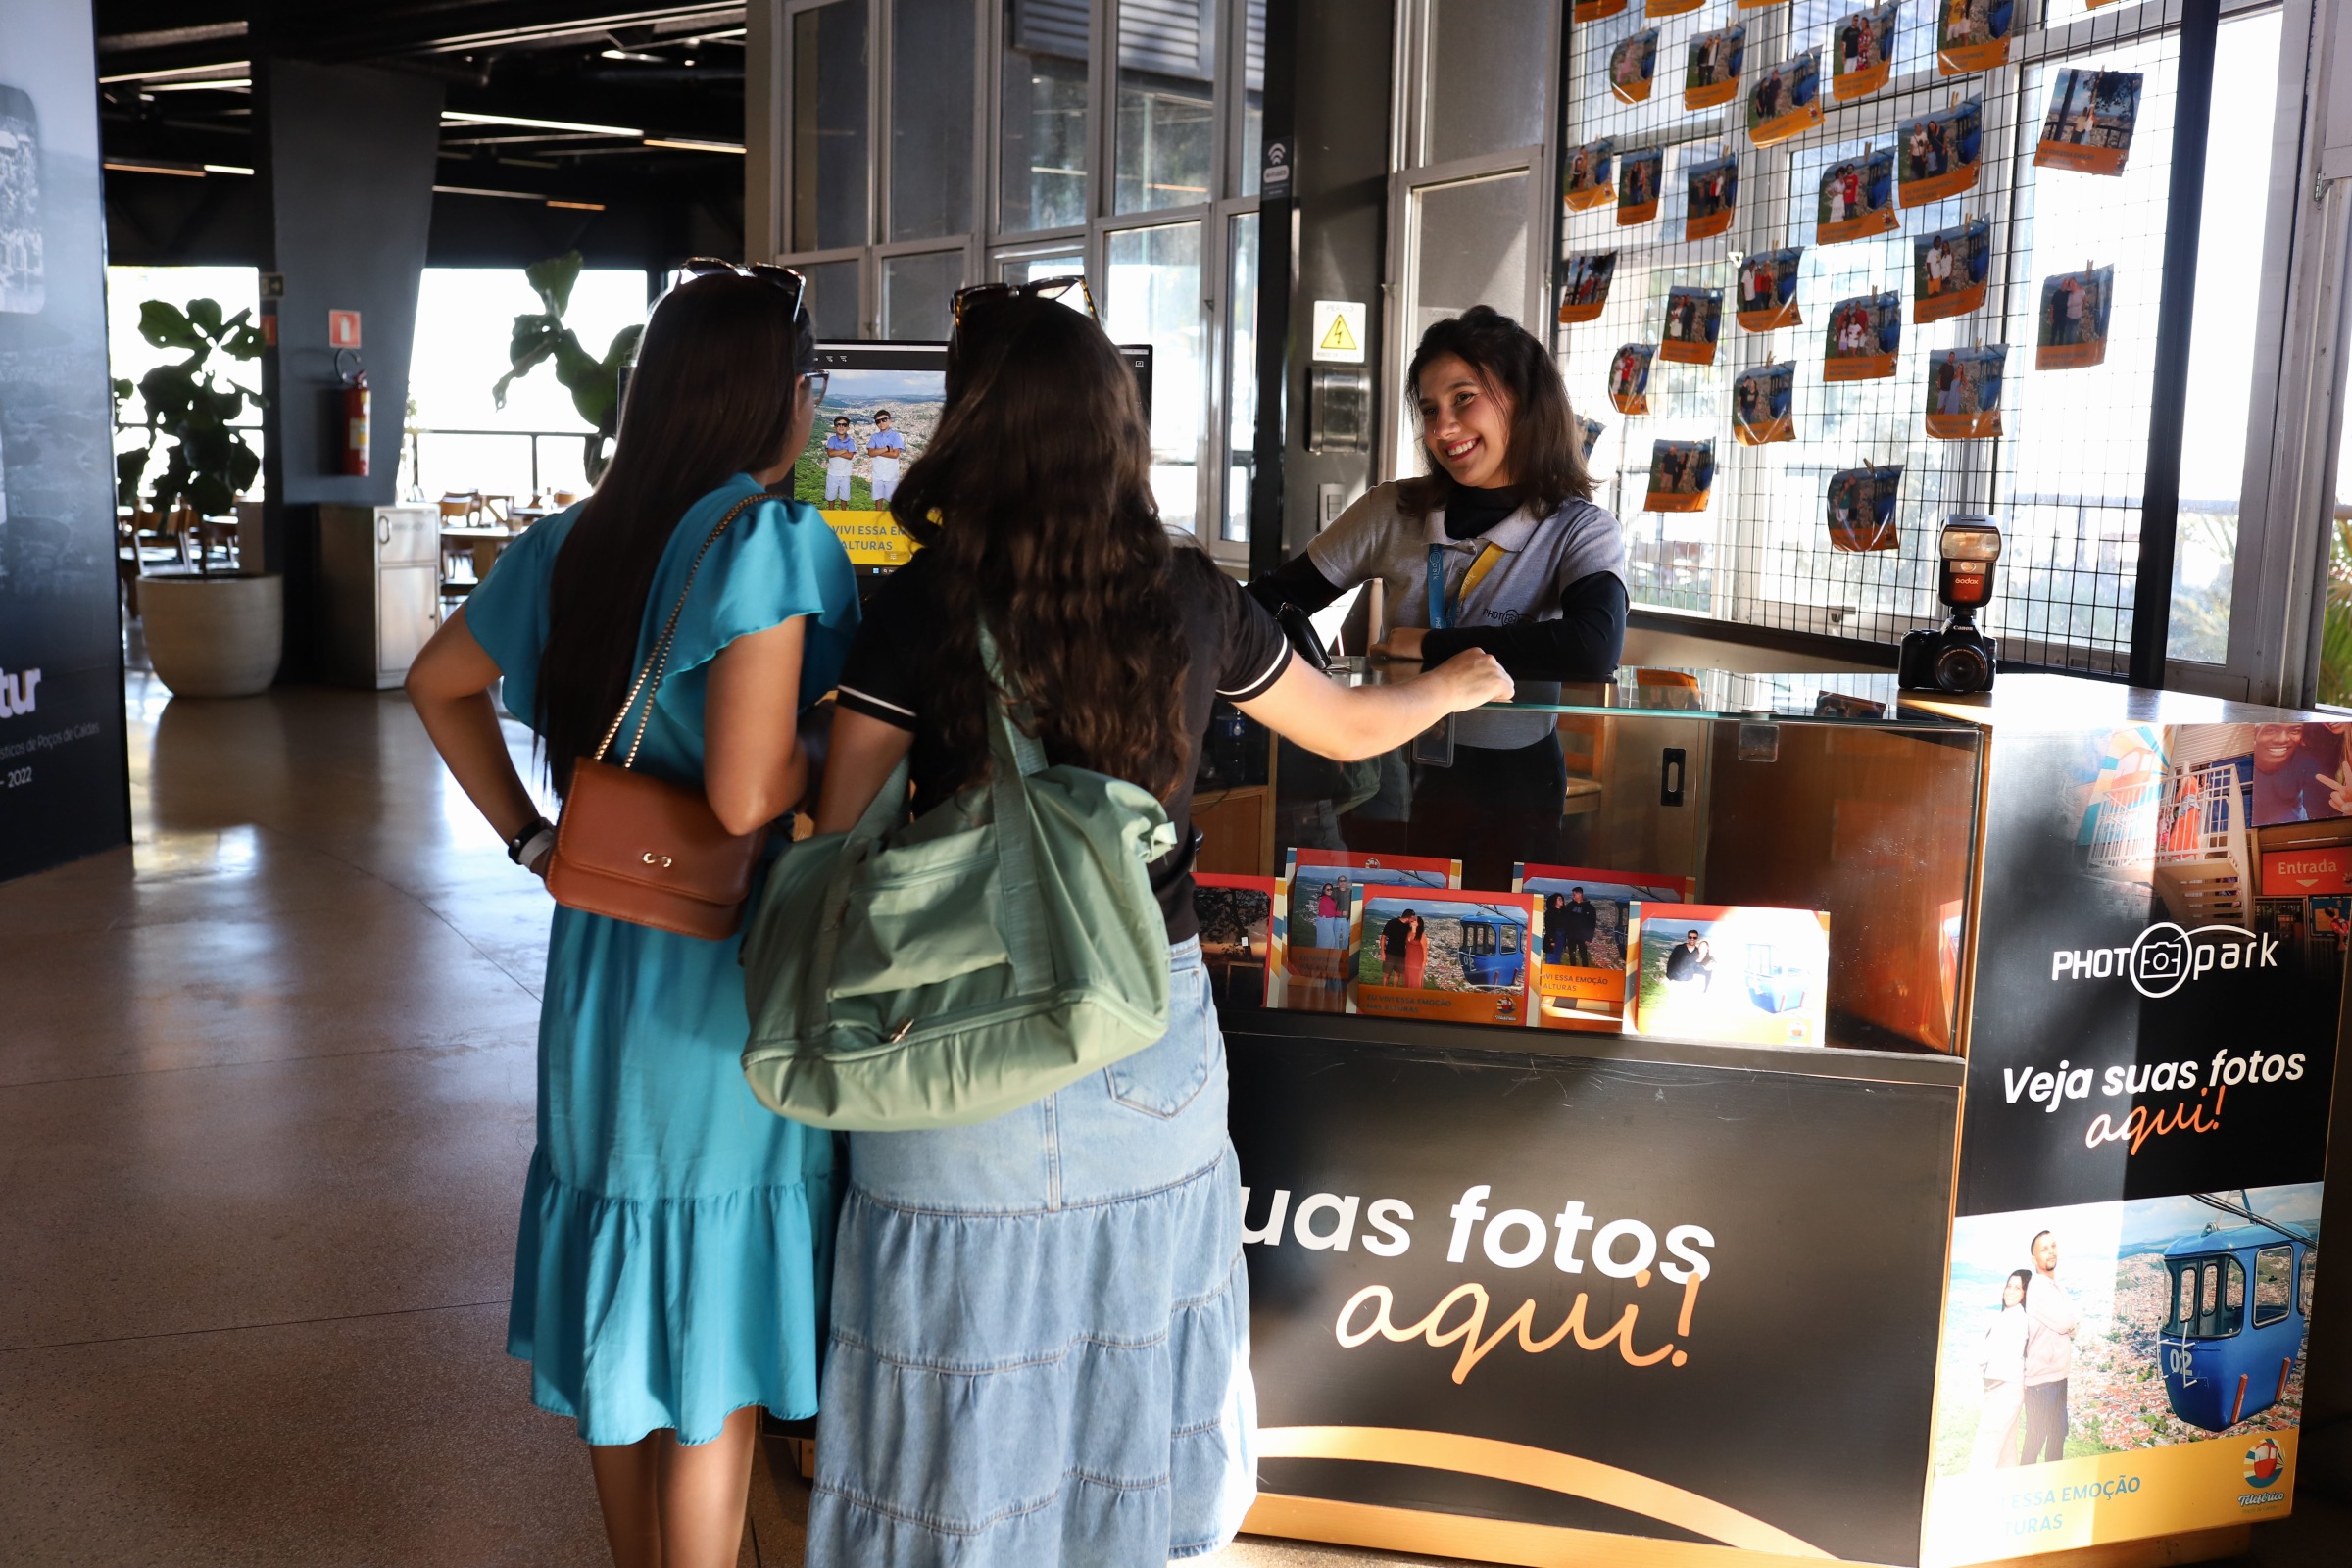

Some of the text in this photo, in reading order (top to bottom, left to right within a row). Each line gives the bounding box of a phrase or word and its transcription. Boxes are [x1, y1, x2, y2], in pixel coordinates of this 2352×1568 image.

[858, 526, 887, 536] ESSA
[841, 540, 893, 550] ALTURAS
[26, 737, 37, 752] de
[37, 733, 63, 750] Poços
[63, 727, 74, 742] de
[8, 766, 32, 788] 2022
[2278, 858, 2337, 875] Entrada
[1576, 976, 1608, 985] EMOÇÃO
[1417, 998, 1451, 1006] EMOÇÃO
[2003, 1048, 2306, 1112] Veja suas fotos
[2085, 1085, 2227, 1156] aqui!
[1446, 1184, 1716, 1285] fotos
[1335, 1269, 1701, 1385] aqui!
[2170, 1348, 2193, 1376] 02
[2011, 1490, 2056, 1509] ESSA
[2062, 1475, 2141, 1501] EMOÇÃO
[2237, 1491, 2285, 1507] Teleférico
